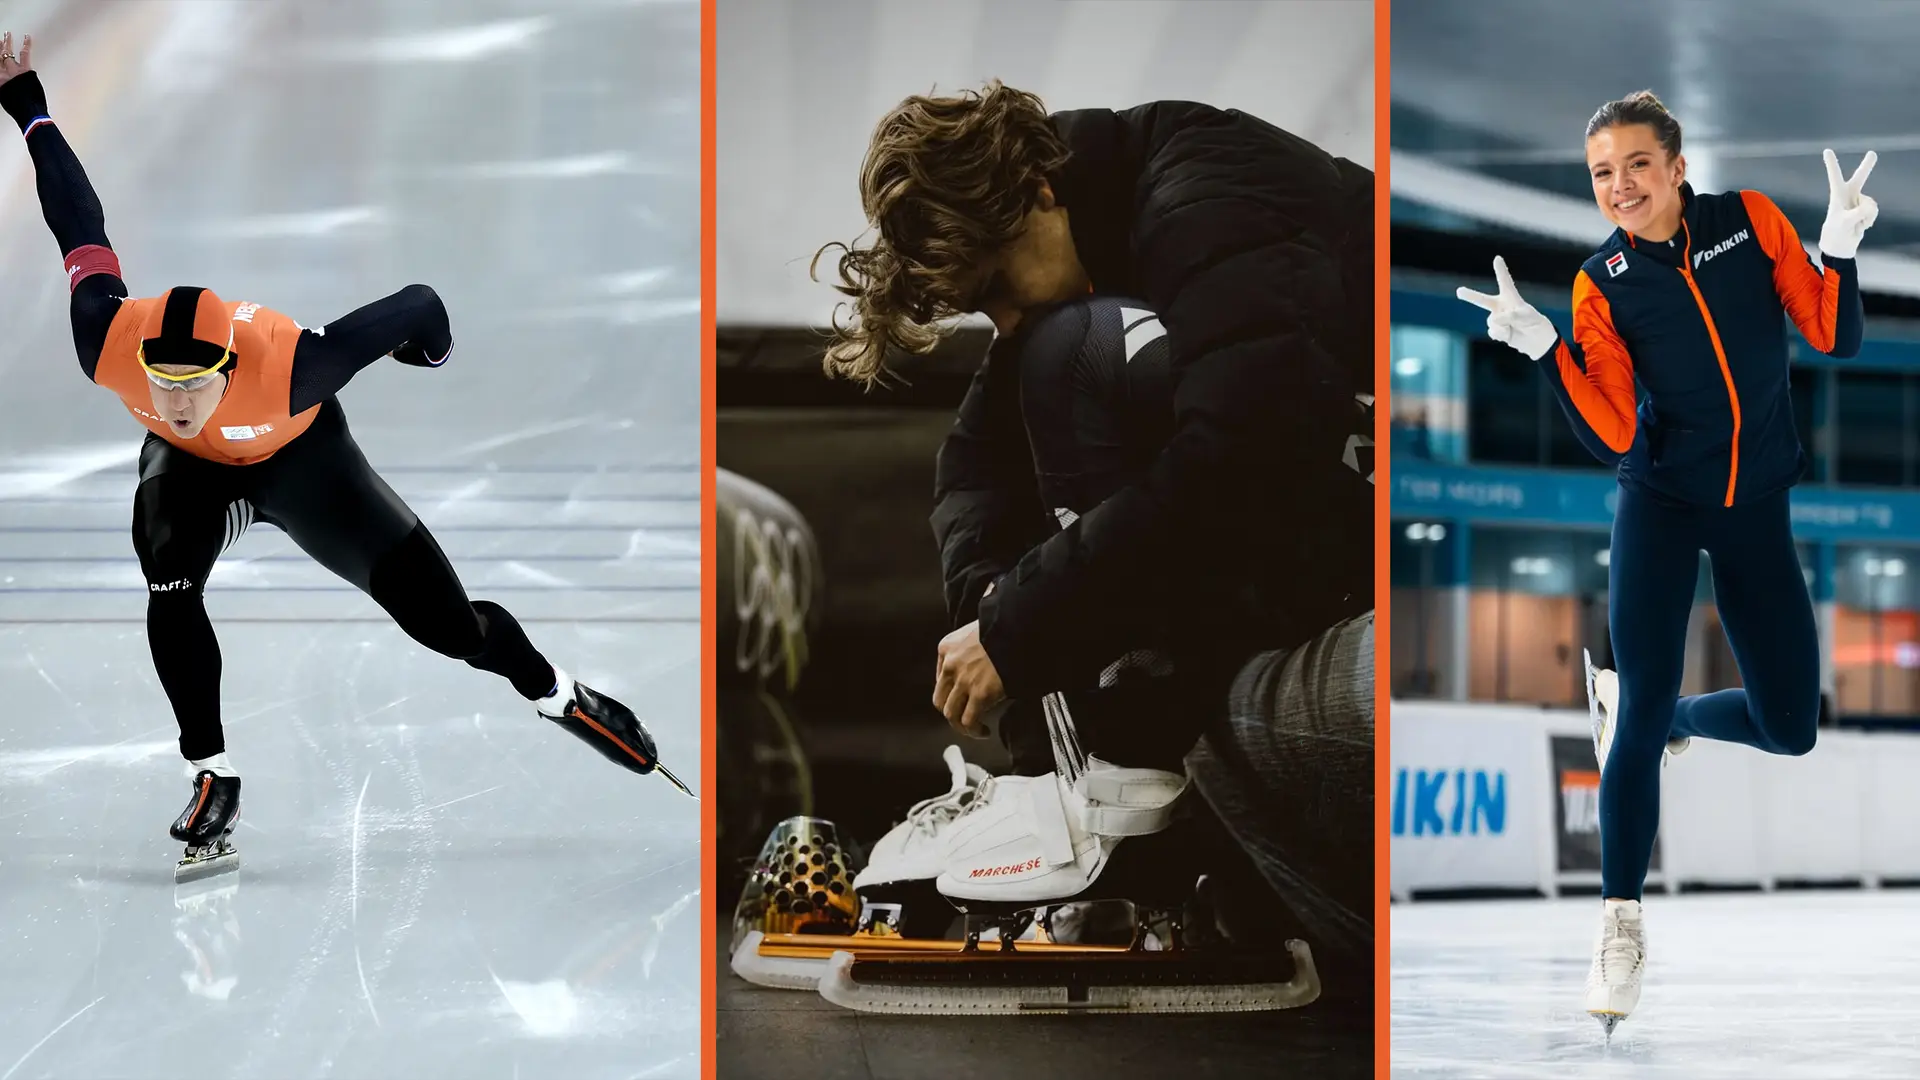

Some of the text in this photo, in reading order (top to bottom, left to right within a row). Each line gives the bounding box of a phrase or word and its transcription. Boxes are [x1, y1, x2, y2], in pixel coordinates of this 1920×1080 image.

[1704, 229, 1749, 262] DAIKIN
[150, 580, 181, 592] CRAFT
[969, 856, 1042, 879] MARCHESE
